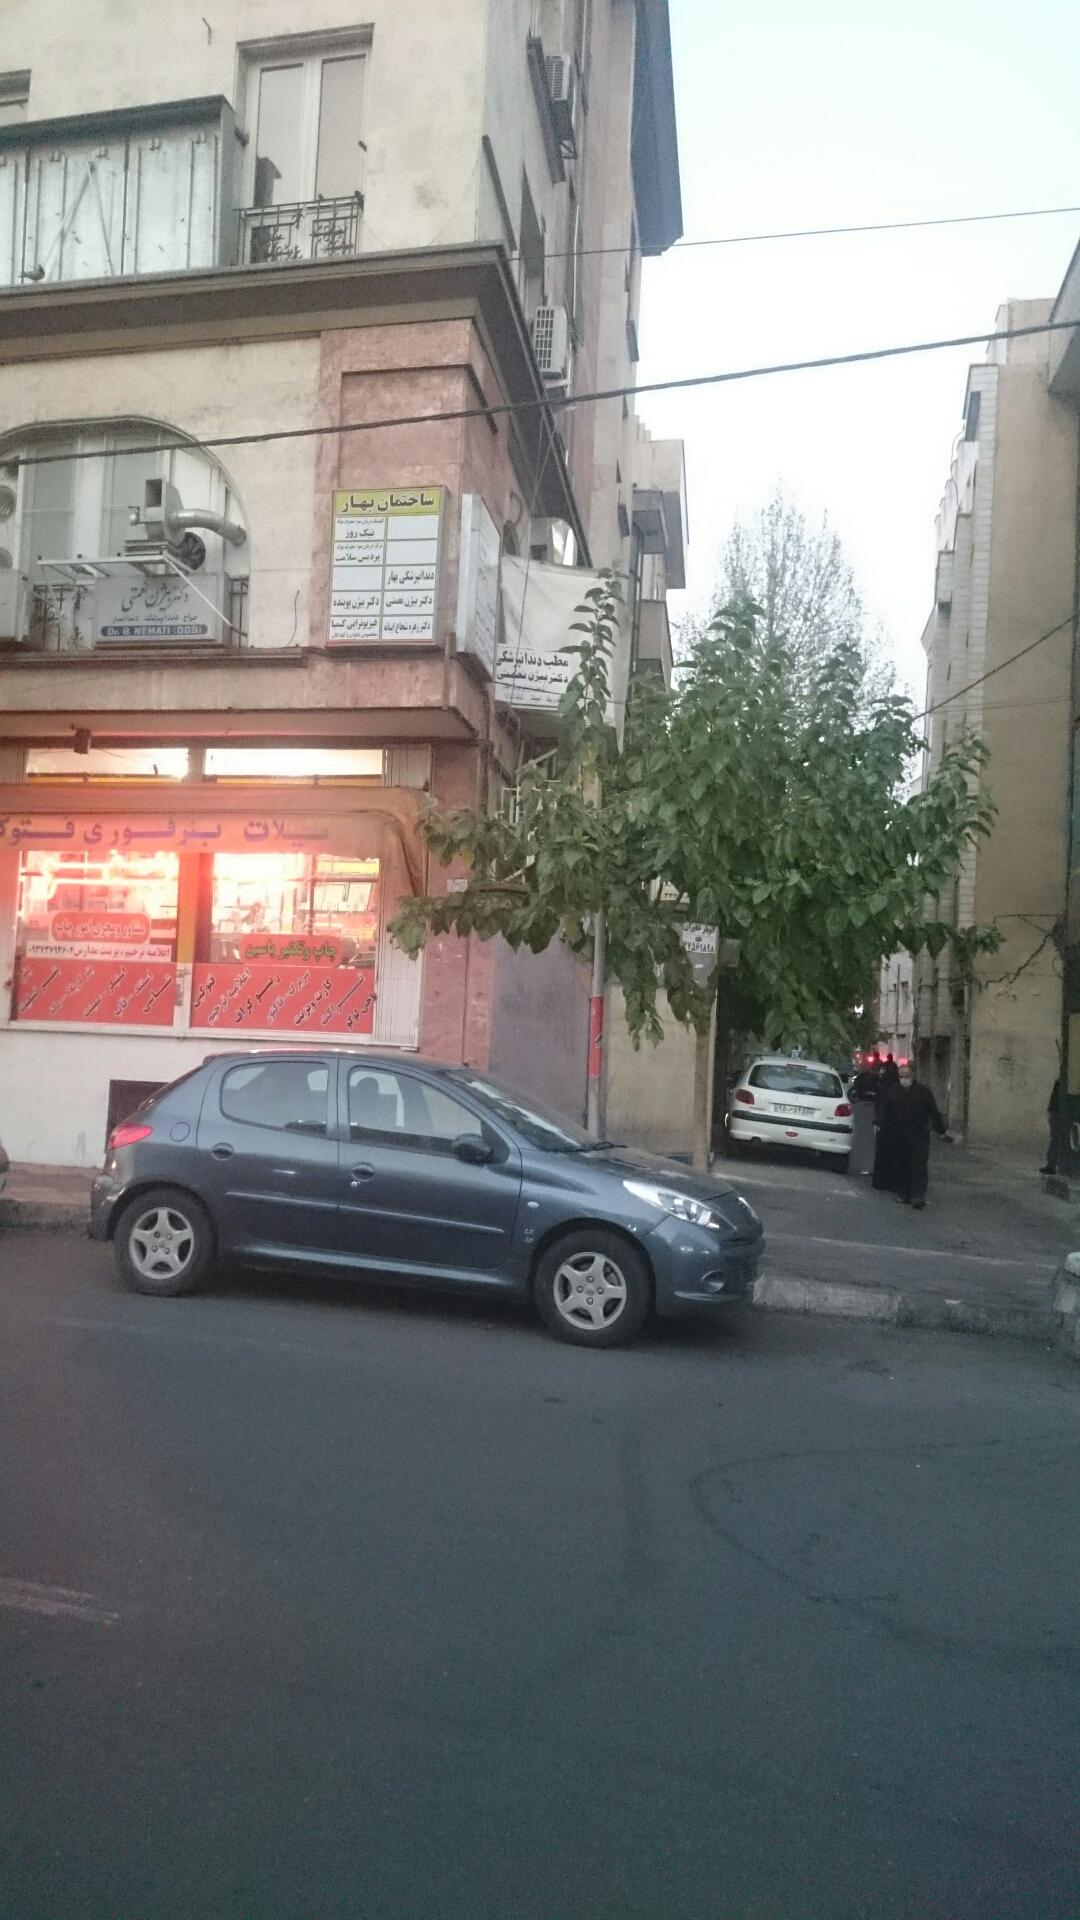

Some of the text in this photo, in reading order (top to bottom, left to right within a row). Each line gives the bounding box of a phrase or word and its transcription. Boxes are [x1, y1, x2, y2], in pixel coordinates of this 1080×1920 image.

[342, 493, 434, 513] ساختمان بهار
[399, 570, 435, 584] دندانپزشکی
[366, 596, 379, 609] دکتر
[419, 596, 432, 607] دکتر
[496, 650, 568, 669] مطب دندانپزشکی
[548, 673, 568, 684] دکتر
